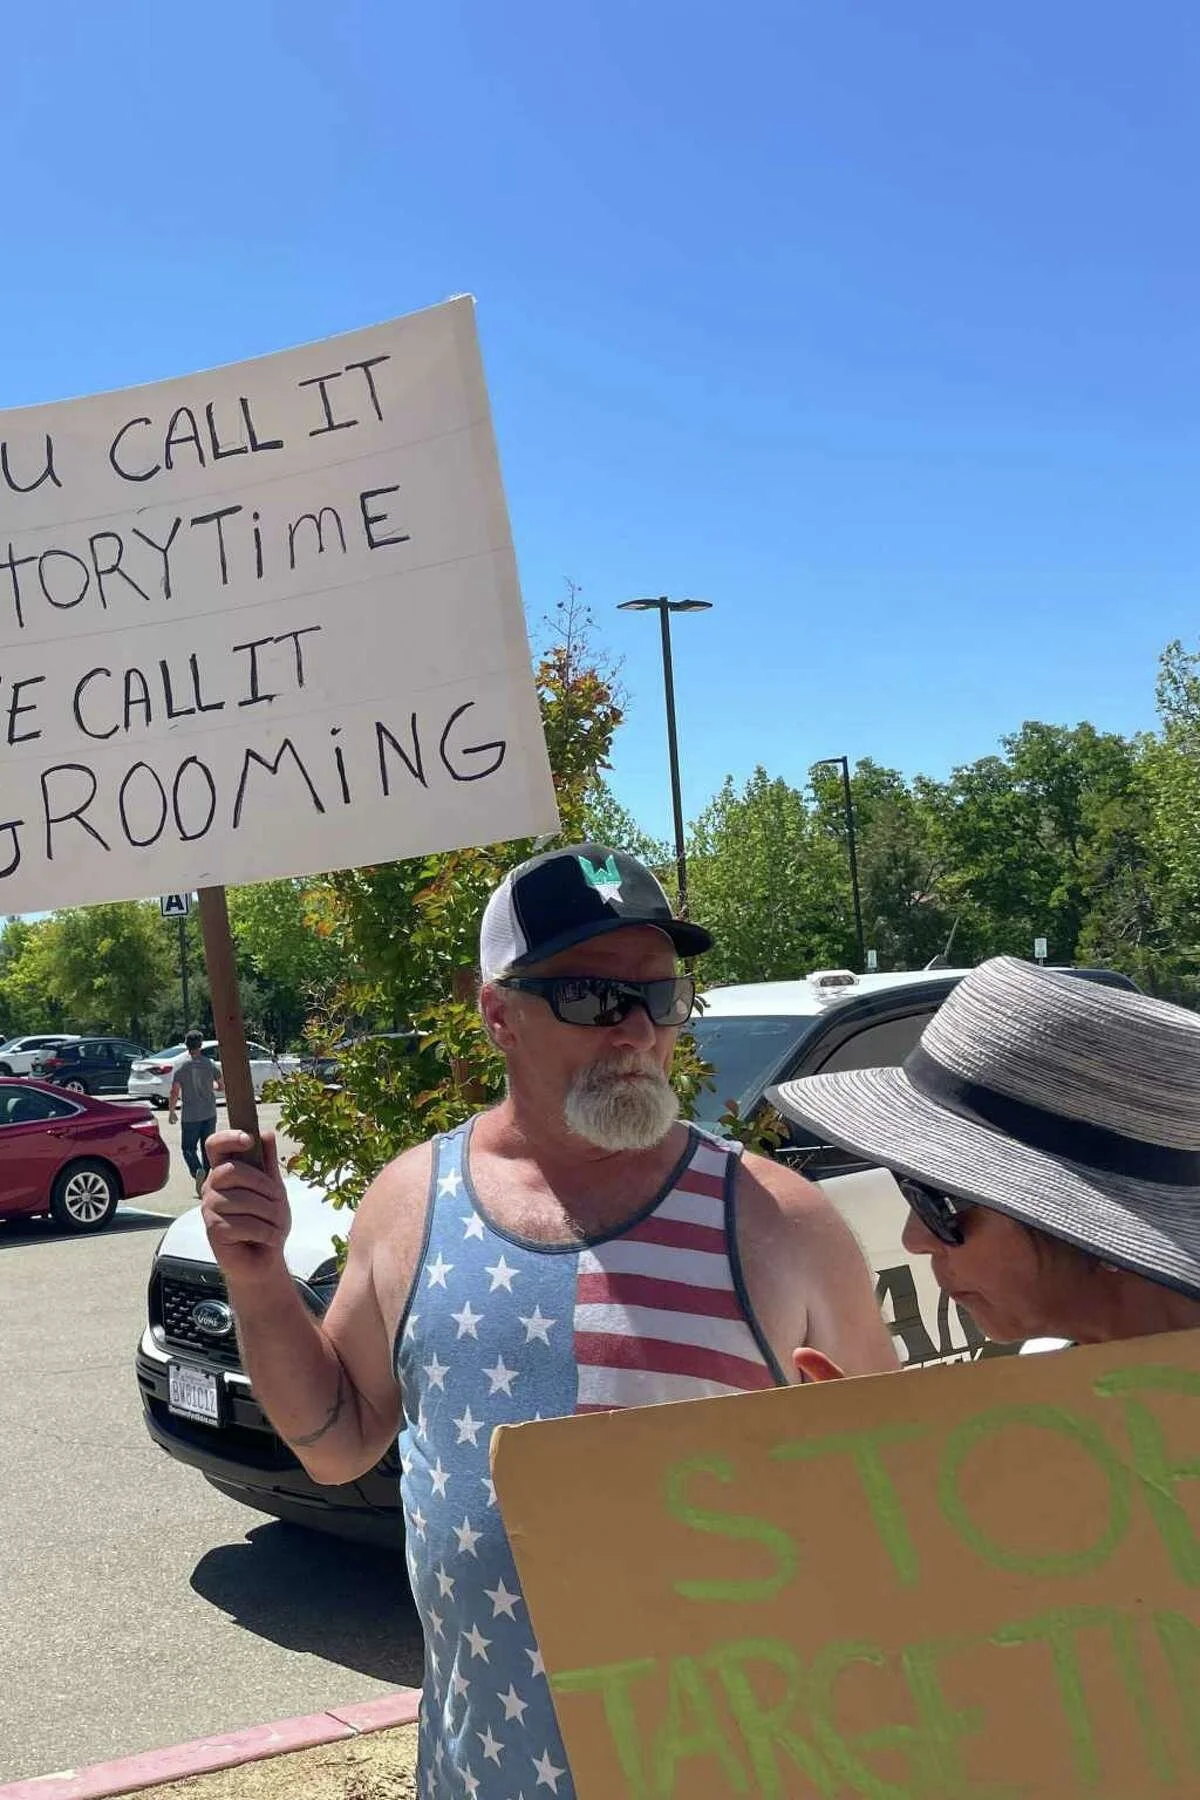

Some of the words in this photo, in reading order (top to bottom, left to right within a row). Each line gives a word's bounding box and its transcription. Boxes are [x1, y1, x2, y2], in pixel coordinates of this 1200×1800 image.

[109, 397, 284, 482] CALL
[298, 355, 391, 437] IT
[73, 654, 224, 740] CALL
[232, 625, 322, 708] IT
[165, 894, 185, 912] A
